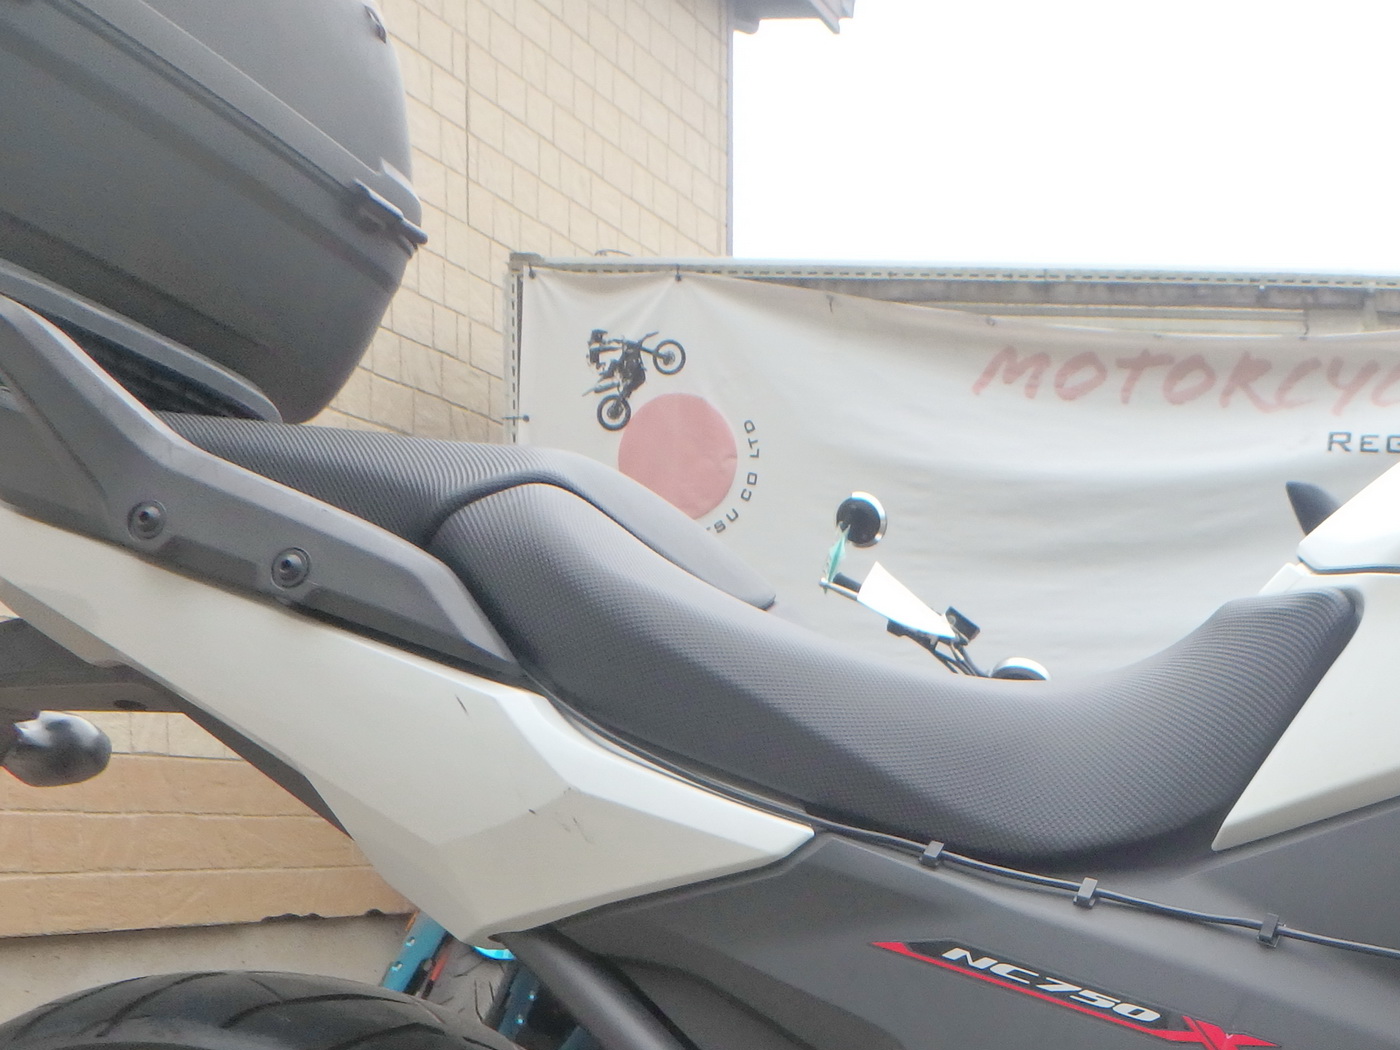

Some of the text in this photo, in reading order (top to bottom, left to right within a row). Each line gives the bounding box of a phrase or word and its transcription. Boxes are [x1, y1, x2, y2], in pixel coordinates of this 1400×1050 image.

[706, 419, 760, 534] SU CO LTD
